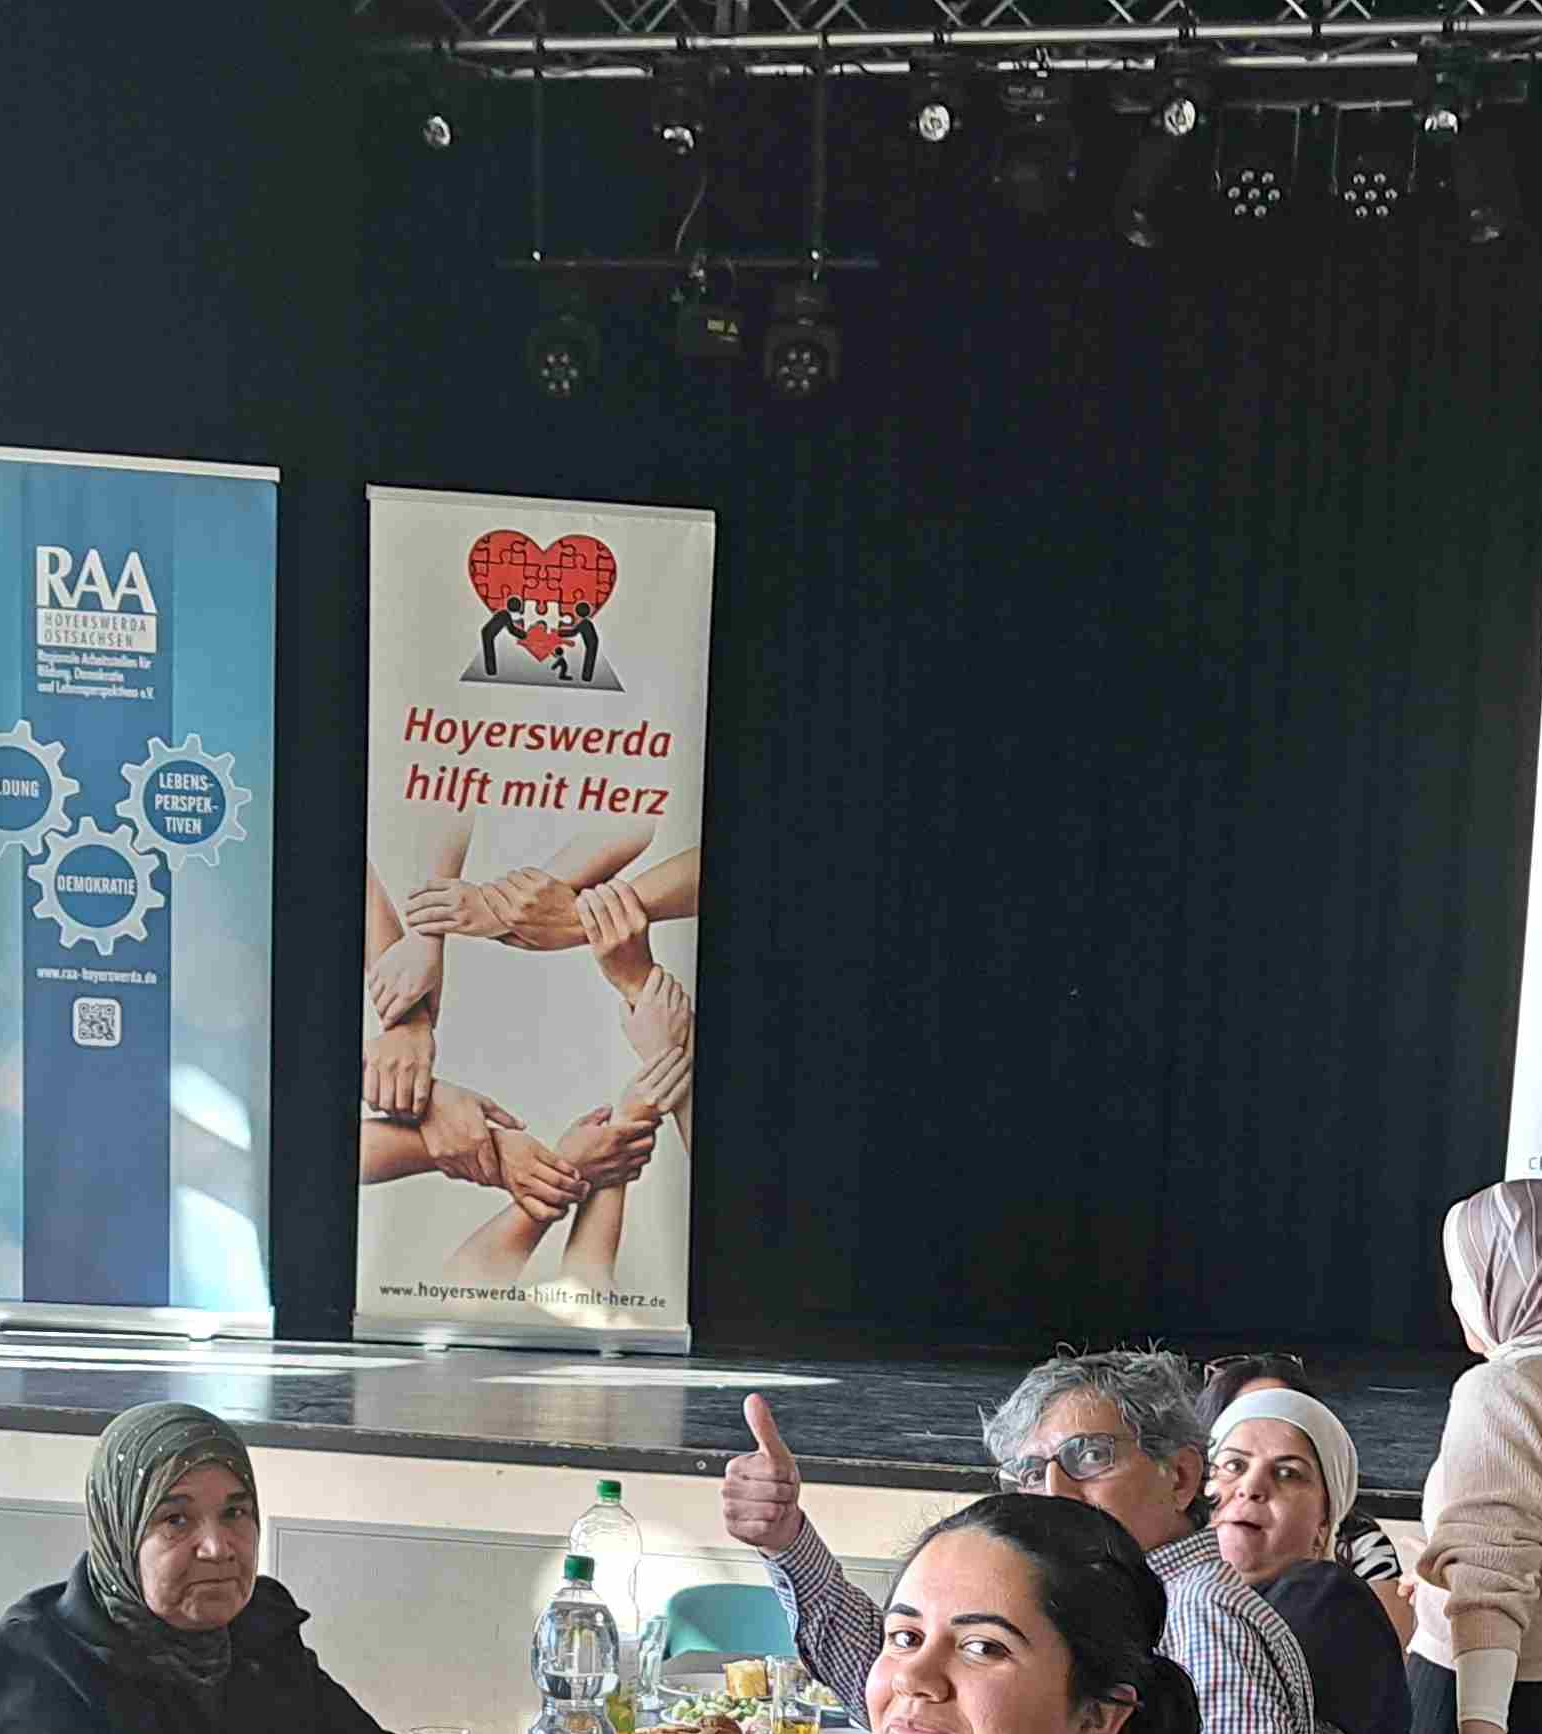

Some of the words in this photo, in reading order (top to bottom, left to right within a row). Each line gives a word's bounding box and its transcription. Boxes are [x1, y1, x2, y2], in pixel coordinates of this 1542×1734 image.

[36, 545, 157, 613] RAA
[44, 612, 147, 632] HOYERSWERDA
[44, 628, 134, 648] OSTSACHSEN
[404, 706, 672, 758] Hoyerswerda
[159, 772, 214, 792] LEBENS-
[405, 764, 492, 812] hilft
[501, 773, 569, 810] mit
[578, 777, 669, 816] Herz
[155, 794, 219, 813] PERSPEK-
[164, 816, 202, 835] TIVEN
[57, 875, 136, 896] DEMOKRATIE
[379, 1281, 667, 1309] www.hoyerswerda-hilft-mit-herz.de
